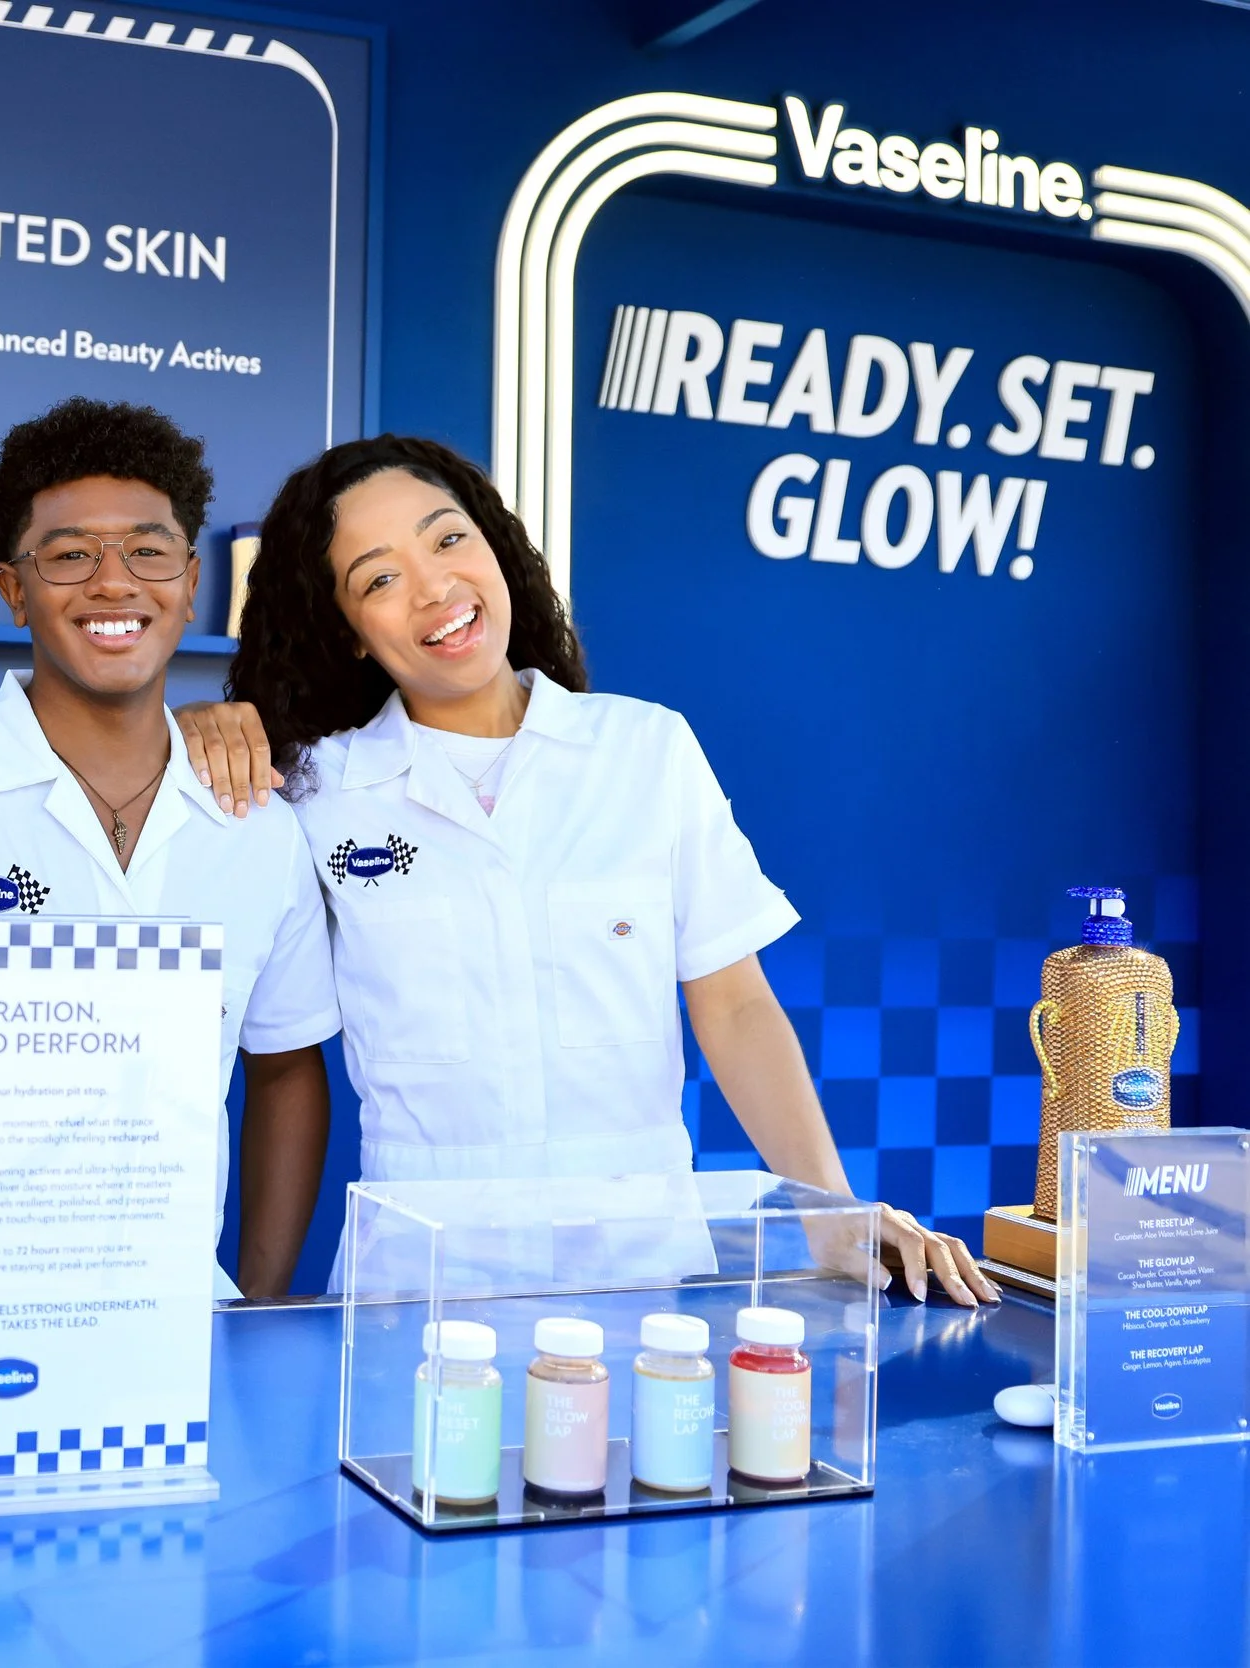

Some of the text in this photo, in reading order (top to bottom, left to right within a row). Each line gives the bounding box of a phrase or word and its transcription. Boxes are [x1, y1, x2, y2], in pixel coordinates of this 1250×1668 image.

[103, 225, 227, 283] SKIN
[74, 331, 164, 372] Beauty
[169, 339, 261, 375] Actives
[648, 310, 1156, 469] READY. SET.
[746, 452, 1048, 580] GLOW!
[17, 1032, 140, 1054] PERFORM
[13, 1086, 63, 1099] hydration
[1137, 1163, 1209, 1196] MENU
[1139, 1217, 1194, 1229] THE RESET LAP
[30, 1244, 59, 1255] hours
[1138, 1256, 1194, 1268] THE GLOW LAP
[21, 1302, 73, 1315] STRONG
[1125, 1311, 1141, 1320] THE
[1194, 1305, 1208, 1314] LAP
[1, 1318, 38, 1330] TAKES
[41, 1317, 64, 1329] THE
[1131, 1345, 1203, 1360] THE RECOVERY LAP
[675, 1394, 699, 1406] THE
[546, 1410, 588, 1424] GLOW
[545, 1425, 571, 1438] LAP
[674, 1422, 698, 1435] LAP
